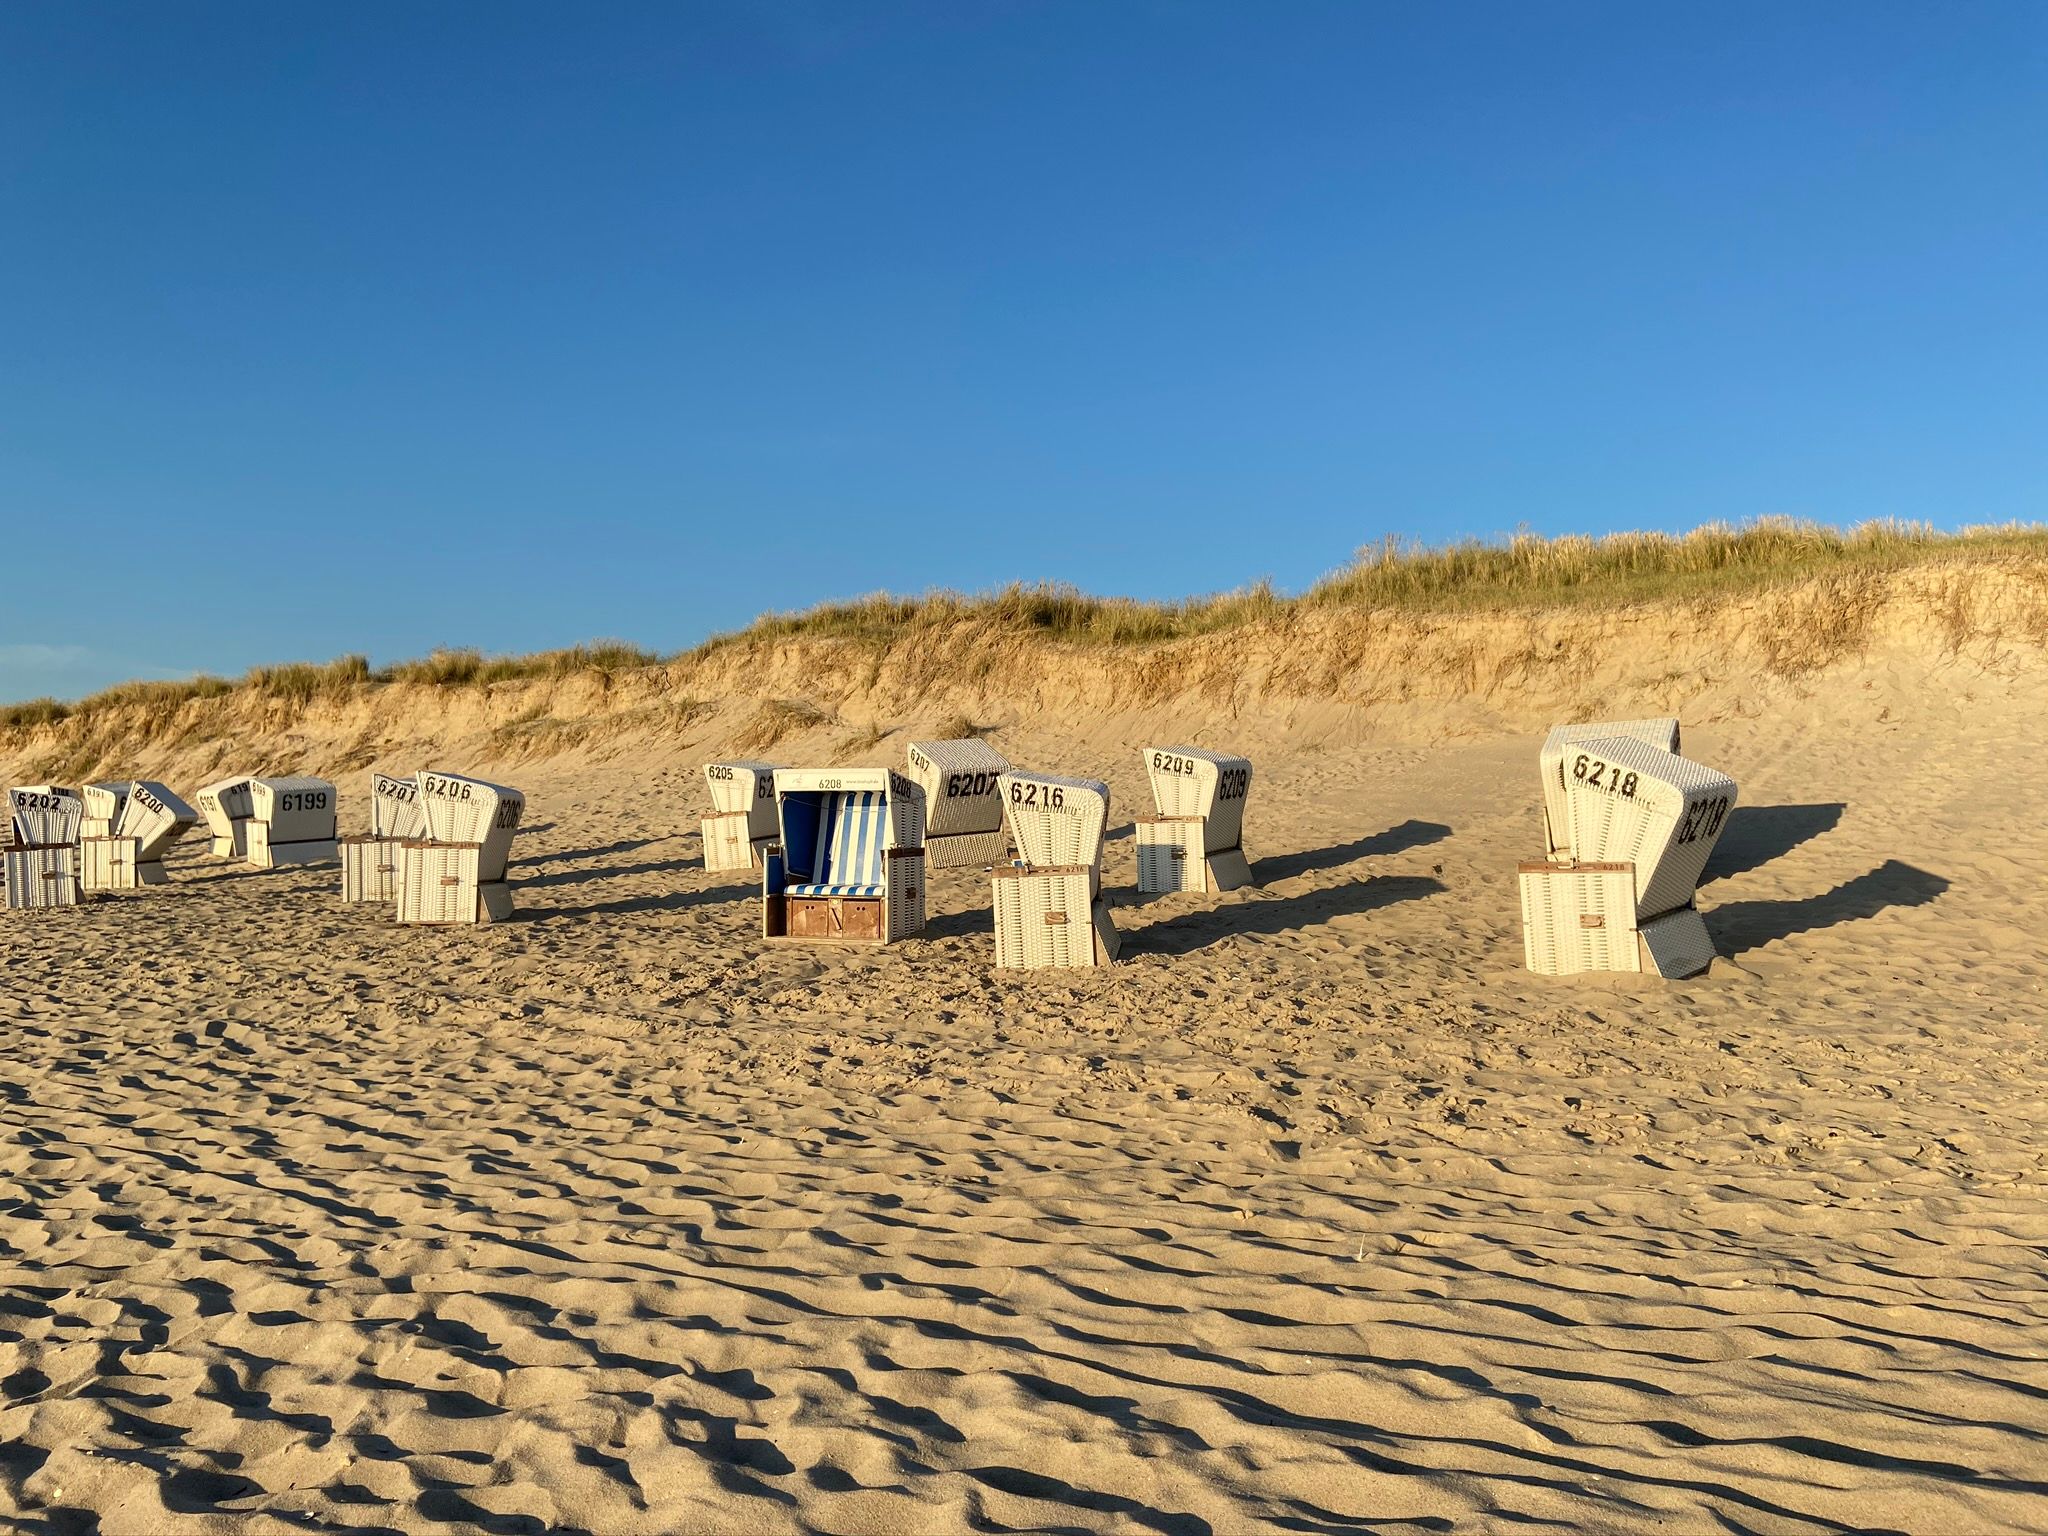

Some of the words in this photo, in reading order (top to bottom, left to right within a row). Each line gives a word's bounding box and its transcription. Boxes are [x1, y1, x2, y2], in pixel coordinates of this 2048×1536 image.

[910, 748, 930, 771] 6207
[1153, 752, 1194, 775] 6209
[708, 766, 733, 780] 6205
[819, 779, 842, 789] 6208
[947, 772, 1000, 797] 6207
[1219, 769, 1247, 800] 6209
[1573, 754, 1639, 798] 6218
[230, 781, 250, 795] 619
[425, 776, 472, 800] 6206
[759, 775, 774, 798] 62
[891, 772, 912, 798] 6208
[1011, 782, 1064, 807] 6216
[18, 793, 60, 810] 6202
[134, 788, 163, 813] 6200
[282, 792, 327, 811] 6199
[496, 800, 521, 829] 6206
